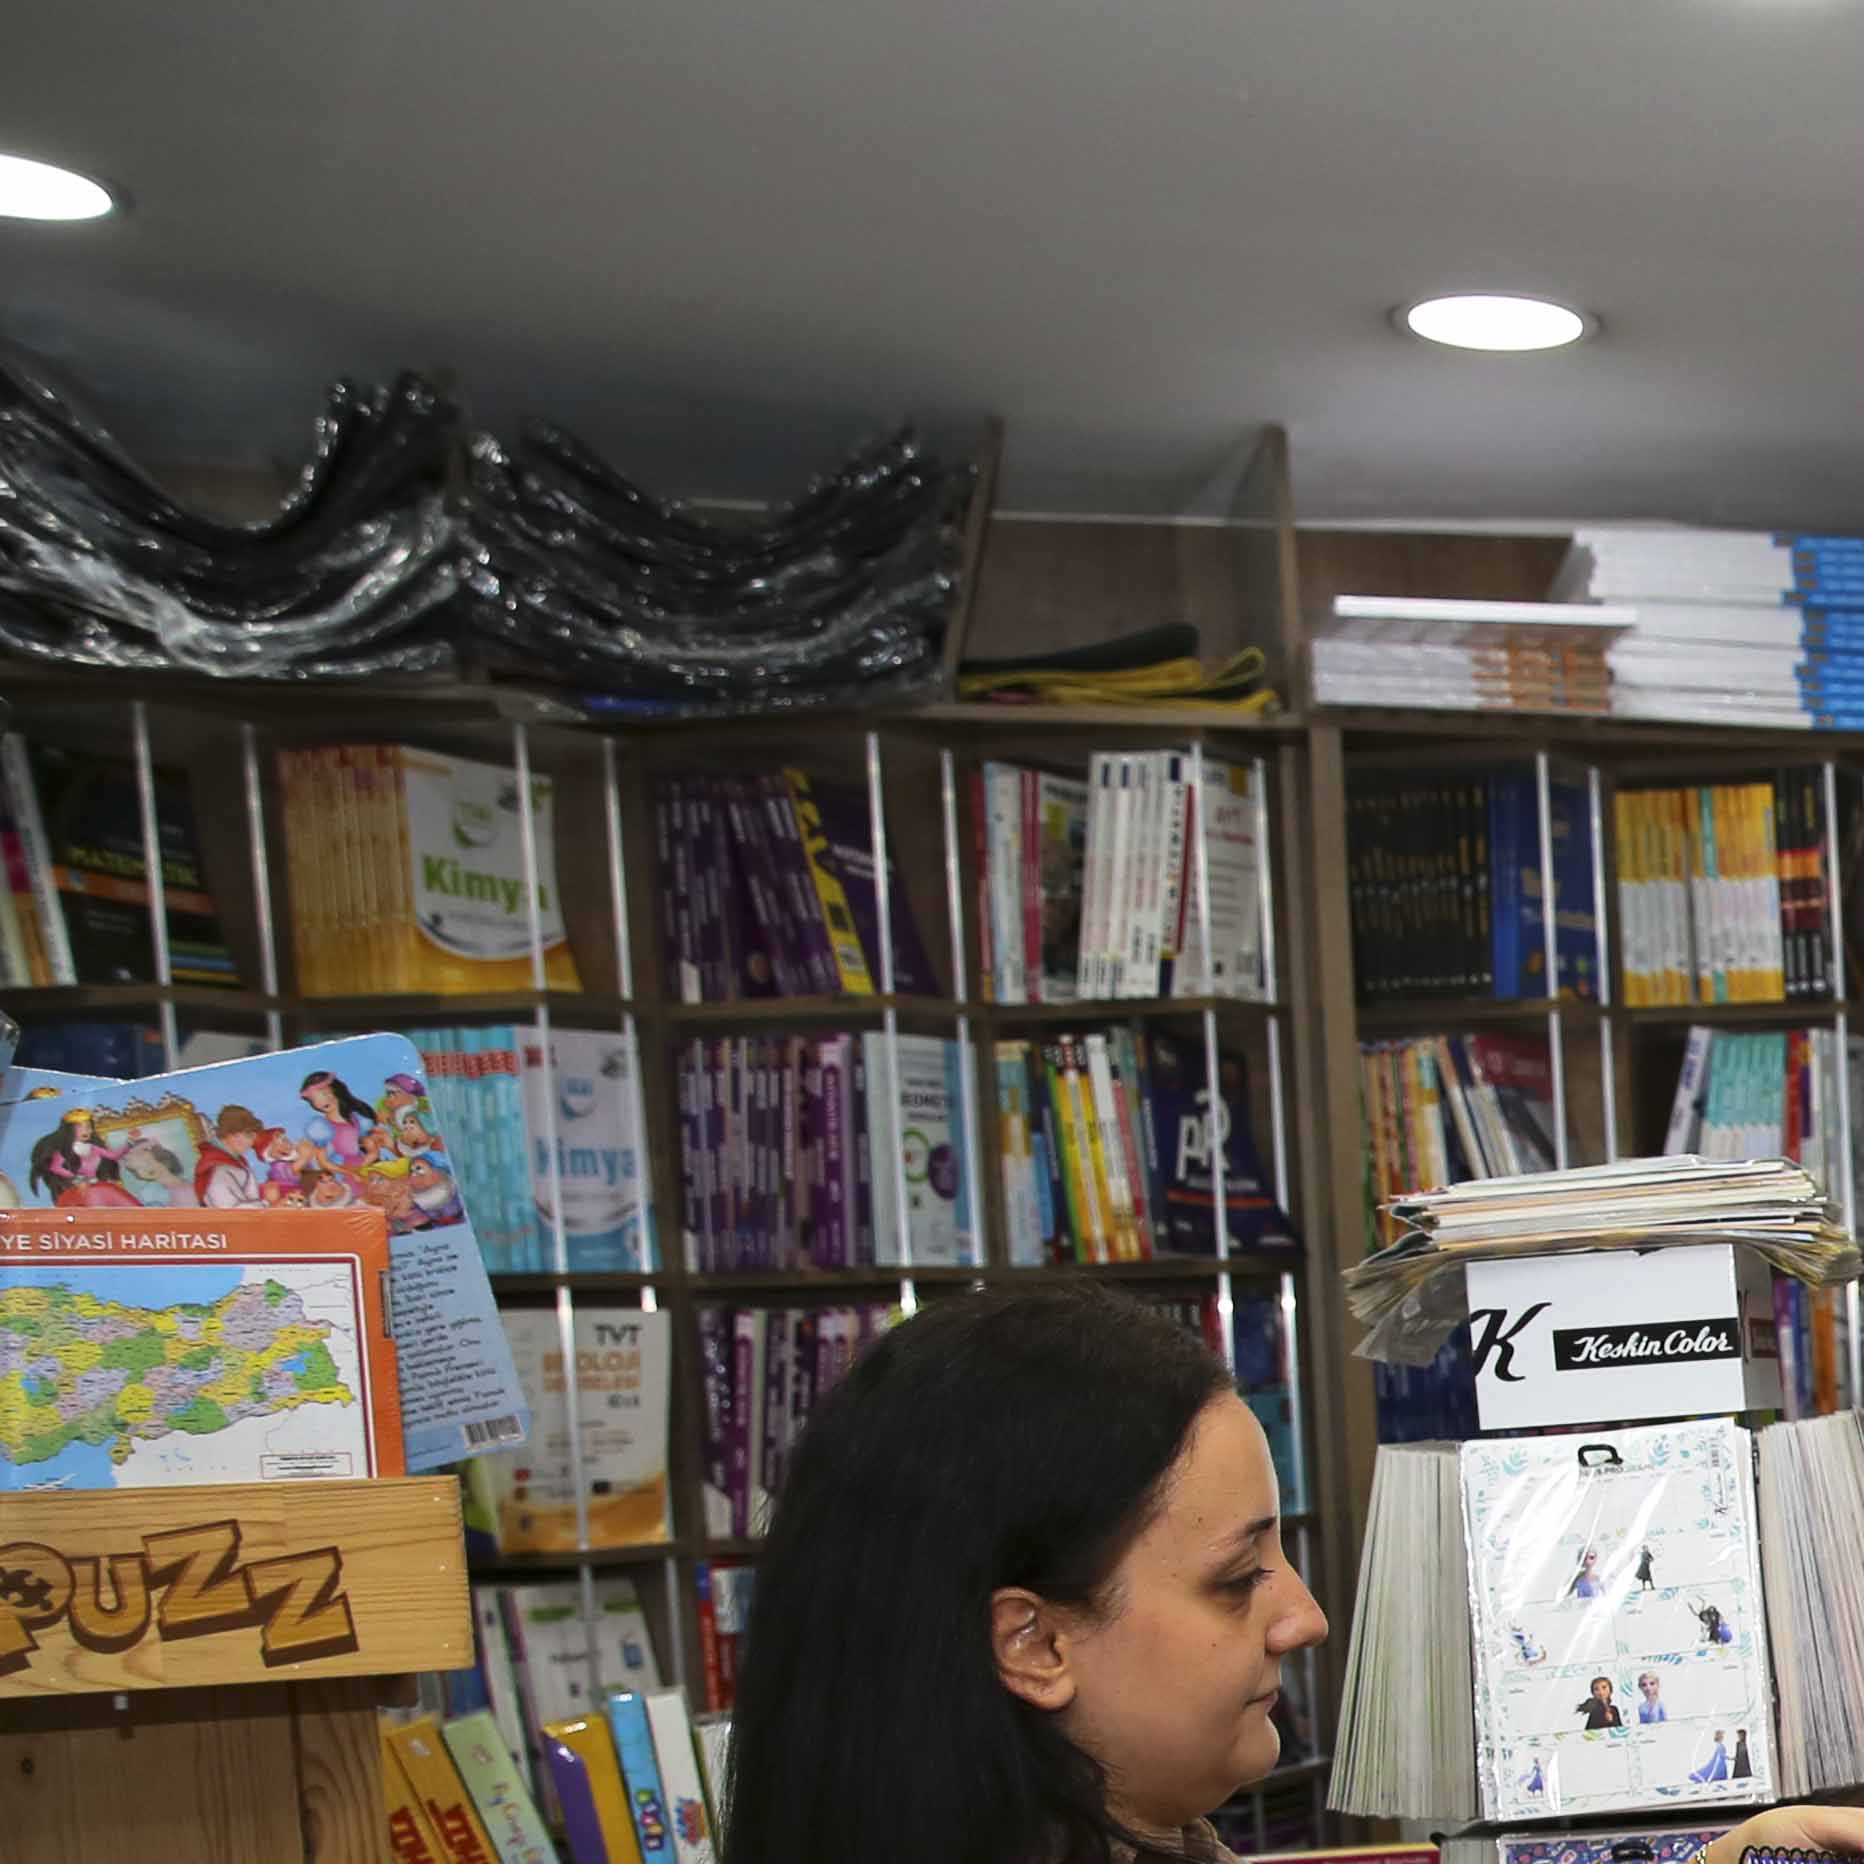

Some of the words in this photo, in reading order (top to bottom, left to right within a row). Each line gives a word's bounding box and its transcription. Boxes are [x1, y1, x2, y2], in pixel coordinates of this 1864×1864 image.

[39, 1230, 113, 1252] SİYASİ
[120, 1229, 228, 1251] HARİTASI
[594, 1323, 642, 1346] TVT
[1470, 1302, 1552, 1384] K
[1571, 1333, 1663, 1364] Keskin
[1664, 1328, 1734, 1356] Color
